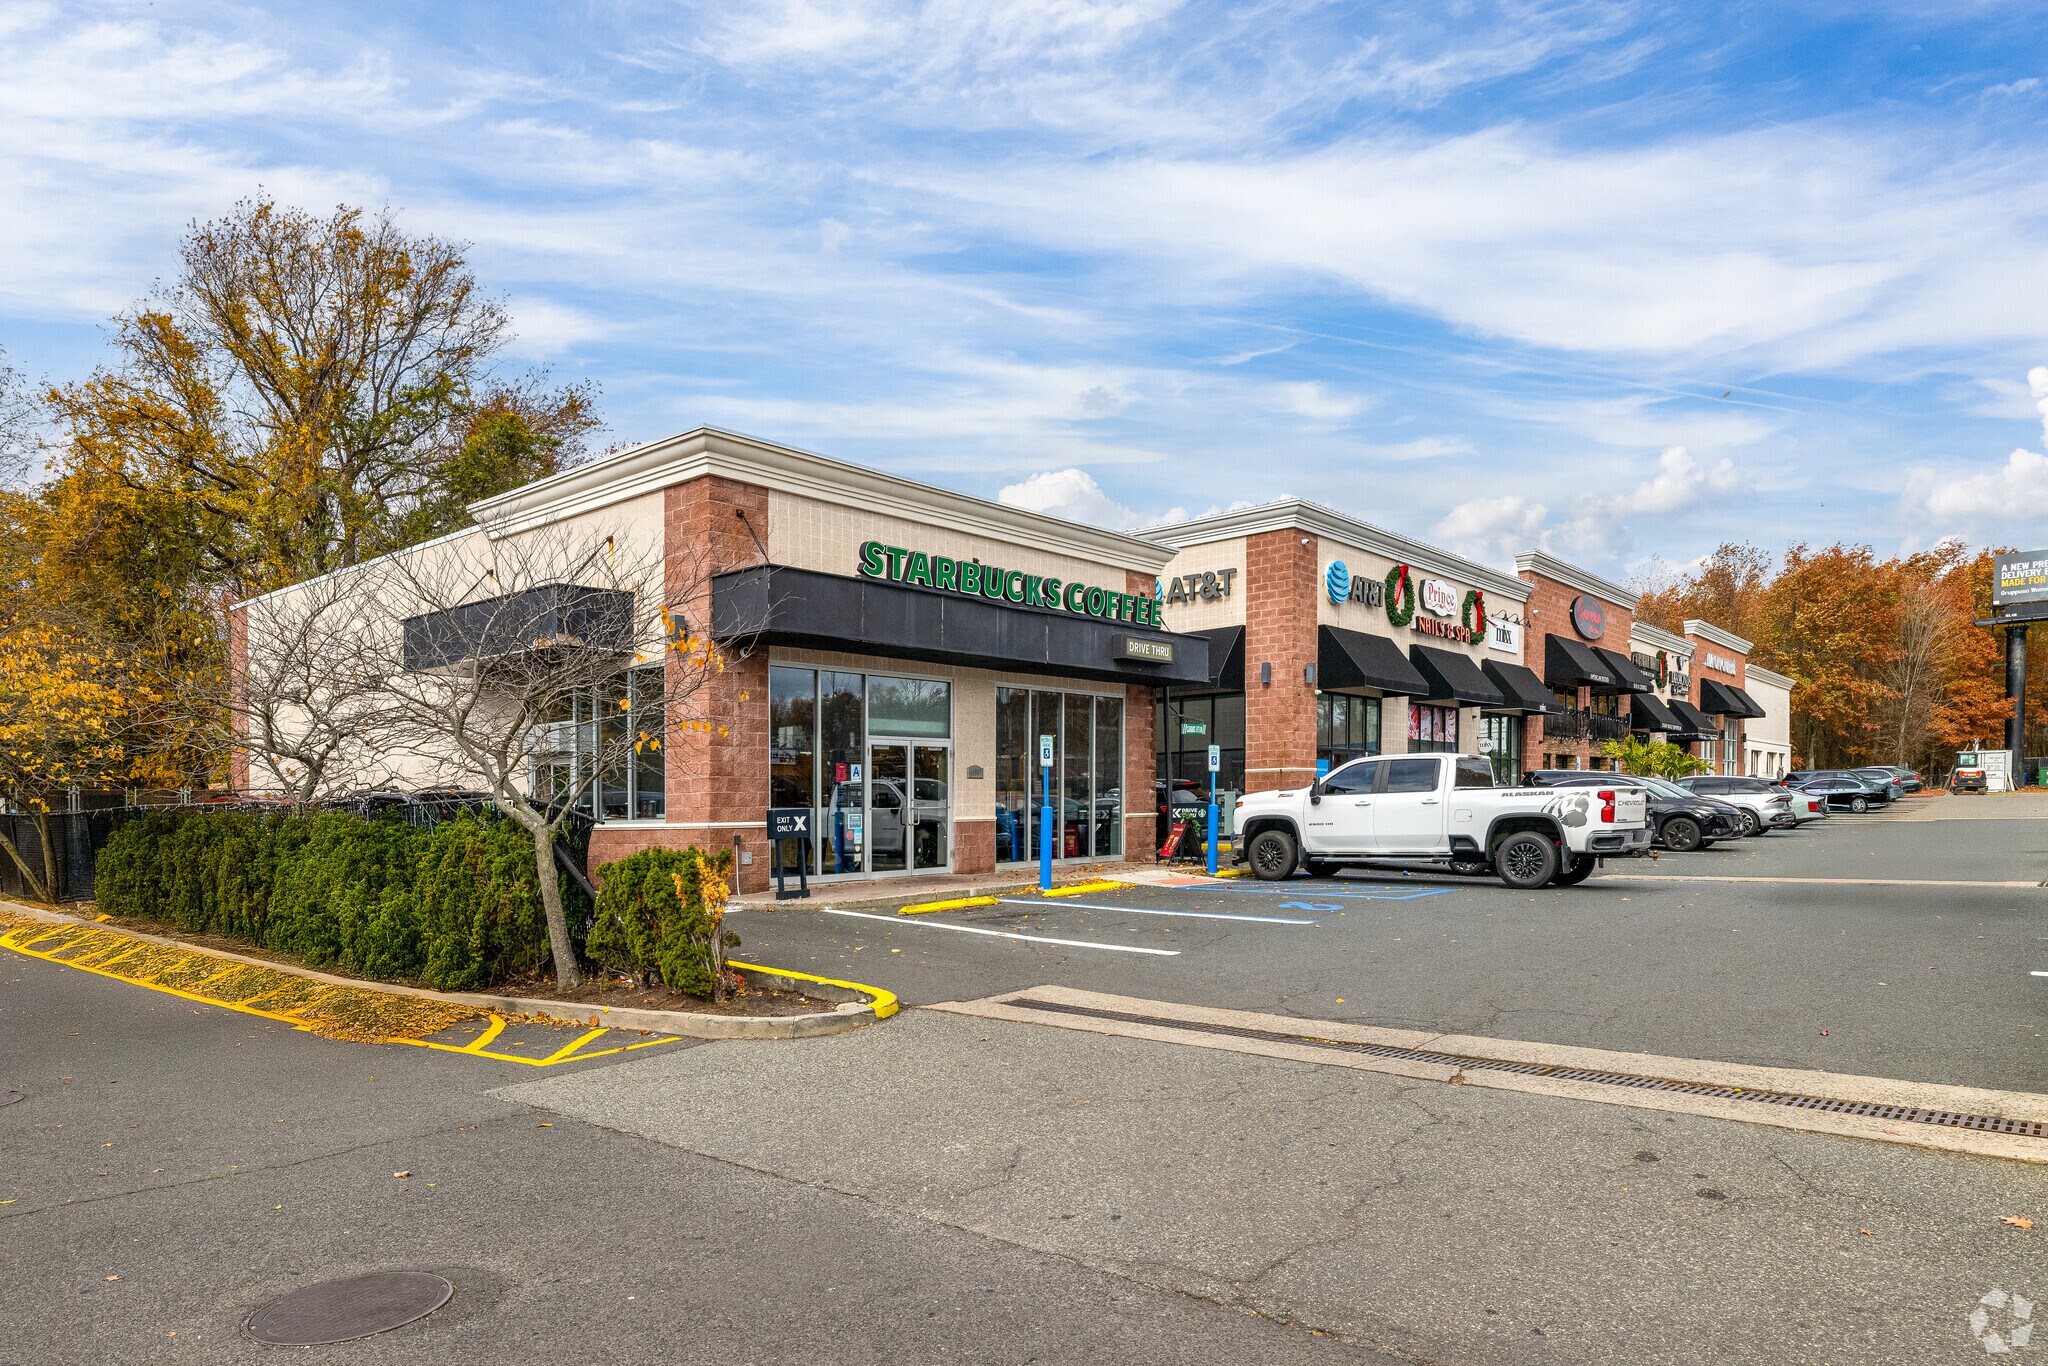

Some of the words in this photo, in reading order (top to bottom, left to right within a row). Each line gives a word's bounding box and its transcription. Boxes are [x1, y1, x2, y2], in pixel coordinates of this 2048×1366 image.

[2001, 564, 2007, 572] A
[2011, 562, 2029, 570] NEW
[2001, 568, 2041, 580] DELIVERY
[858, 541, 1062, 609] STARBUCKS
[1064, 582, 1163, 628] COFFEE
[1166, 568, 1237, 604] AT&T
[2002, 578, 2025, 586] MADE
[2029, 576, 2045, 584] FOR
[1351, 575, 1386, 607] AT&T
[1428, 583, 1455, 606] Prince
[1416, 615, 1445, 637] NAILS
[1454, 625, 1471, 643] SPA
[1128, 641, 1150, 654] DRIVE
[1151, 643, 1169, 656] THRU
[853, 767, 859, 777] A
